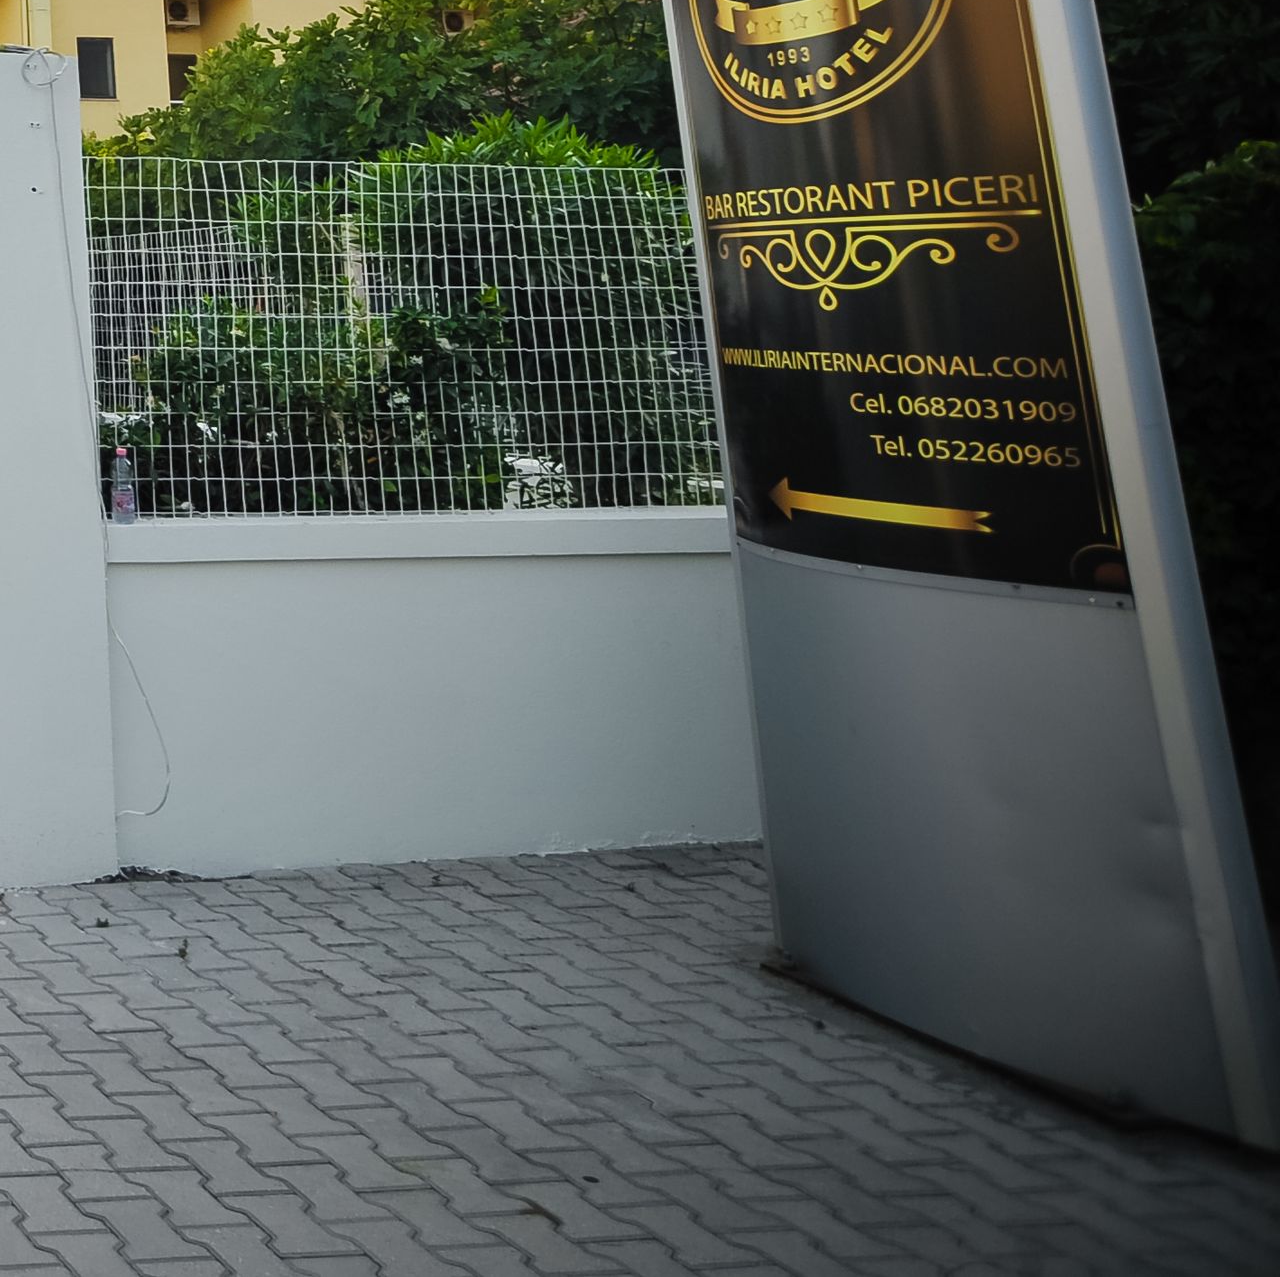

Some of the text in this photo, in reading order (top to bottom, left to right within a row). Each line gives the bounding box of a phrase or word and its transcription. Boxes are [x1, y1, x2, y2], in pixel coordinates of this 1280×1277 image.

[724, 25, 893, 100] ILIRIA HOTEL
[767, 46, 811, 67] 1993
[705, 174, 1038, 220] BAR RESTORANT PICERI
[721, 347, 1068, 379] WWW.ILIRIAINTERNACIONAL.COM
[849, 392, 1077, 423] Cel. 0682031909
[870, 434, 1082, 468] Tel. 052260965
